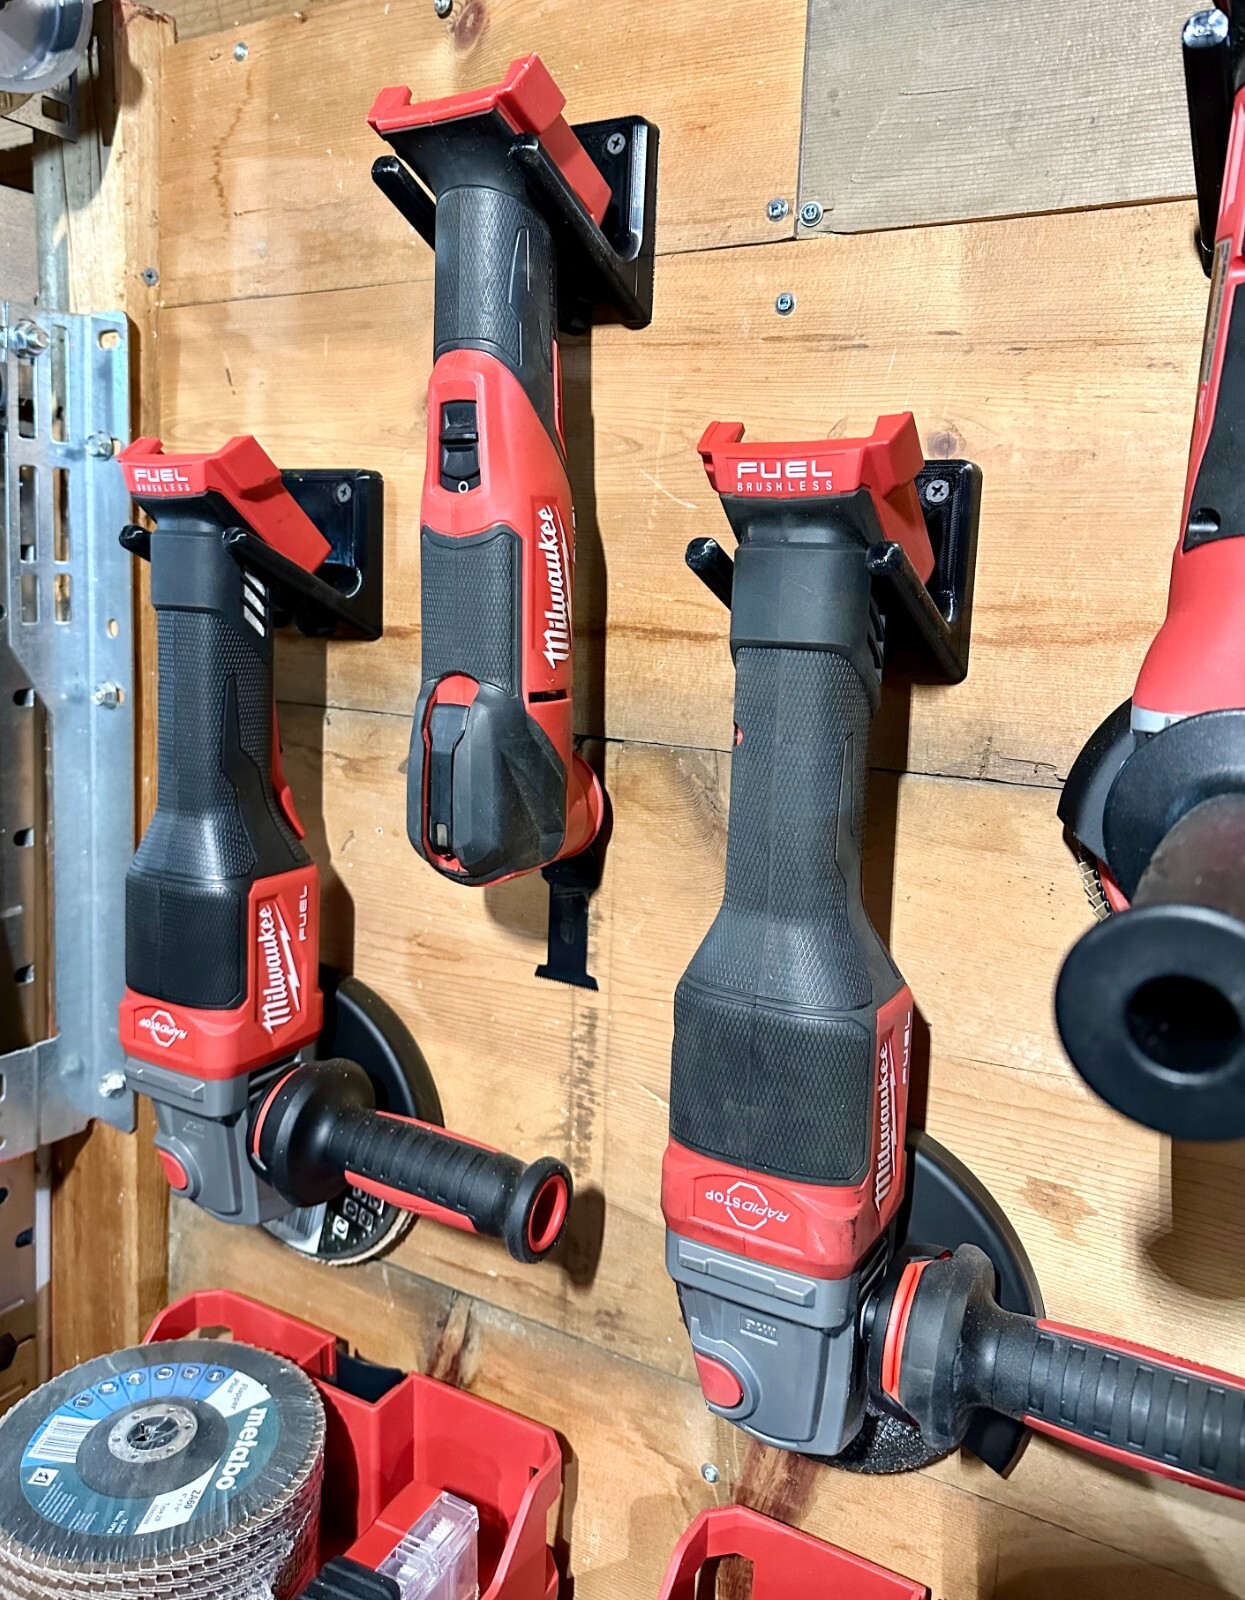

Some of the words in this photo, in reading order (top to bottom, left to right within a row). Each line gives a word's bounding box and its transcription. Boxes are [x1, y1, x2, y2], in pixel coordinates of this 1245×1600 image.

[134, 468, 189, 482] FUEL
[736, 460, 833, 479] FUEL
[136, 483, 191, 492] BRUSHLESS
[737, 480, 833, 492] BRUSHLESS
[538, 504, 570, 669] Milwaukee
[299, 885, 308, 941] FUEL
[258, 903, 292, 1035] Milwaukee
[902, 1011, 911, 1085] FUEL
[875, 1041, 891, 1211] Milwaukee
[227, 1377, 240, 1394] Plus
[231, 1383, 249, 1410] Flapper
[215, 1407, 268, 1490] metabo
[184, 1489, 201, 1509] ZA60
